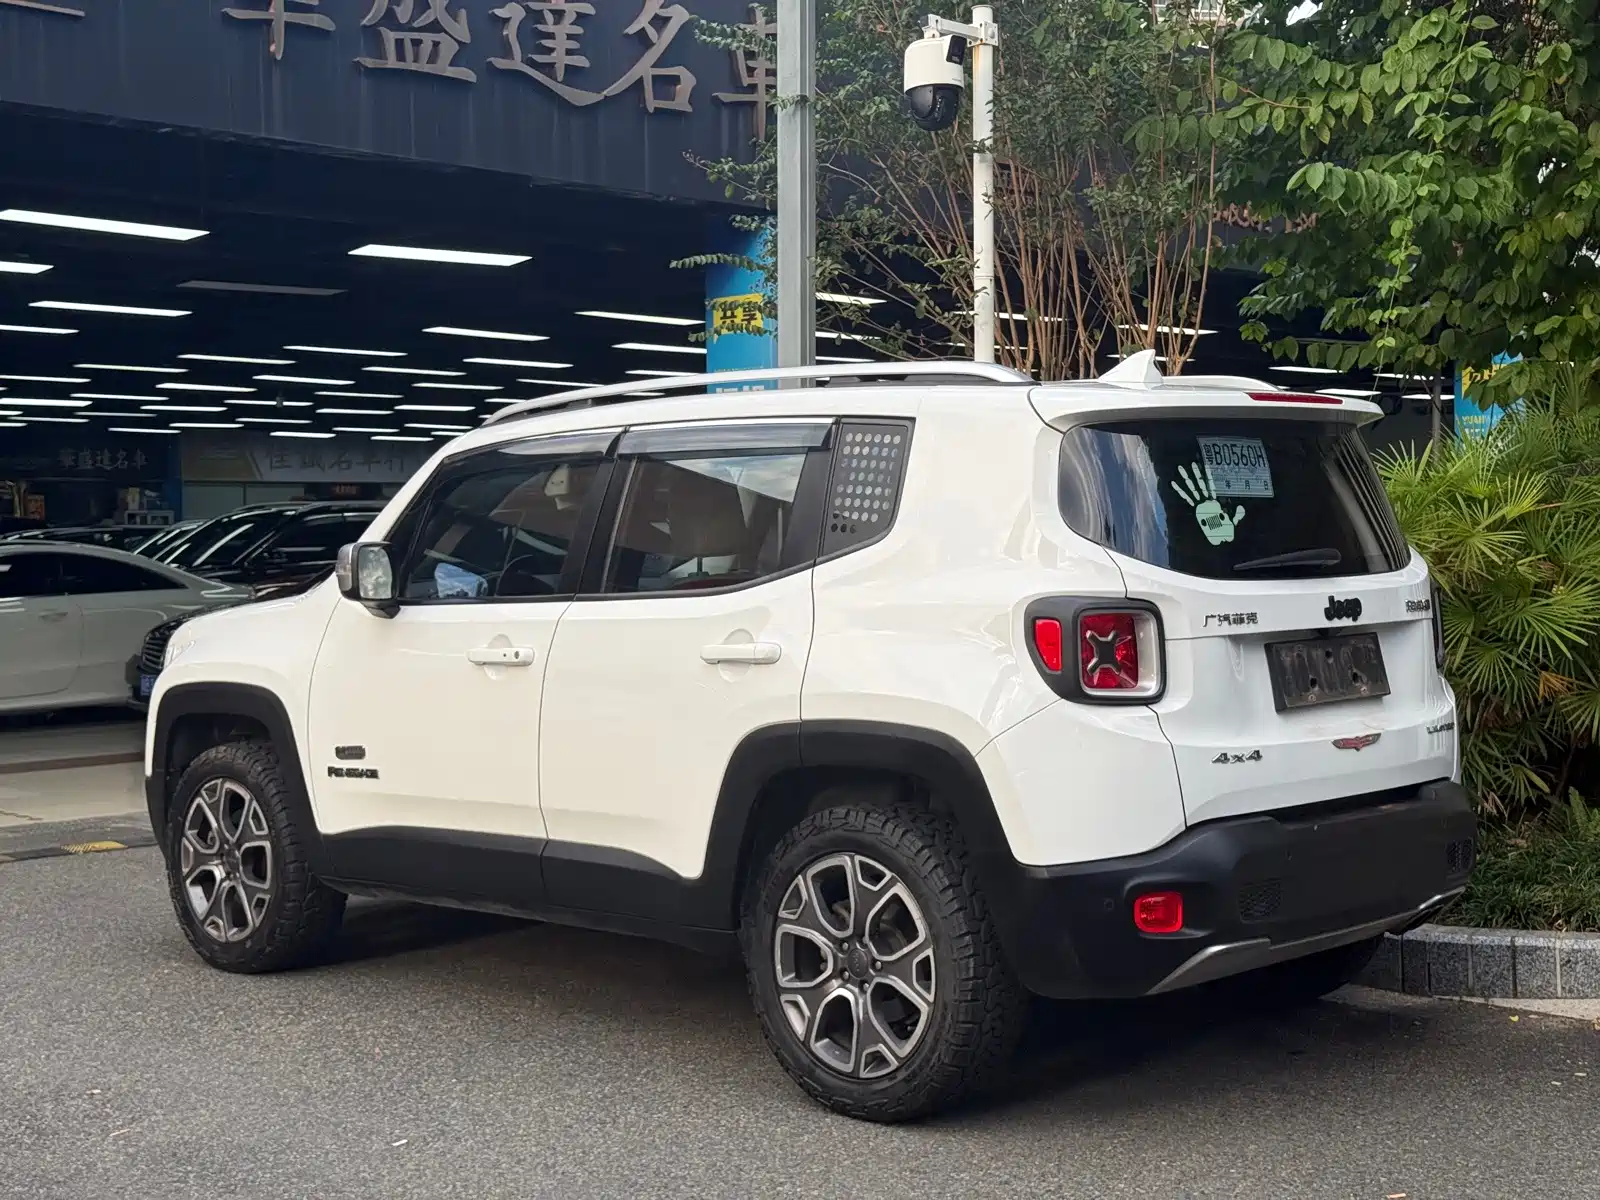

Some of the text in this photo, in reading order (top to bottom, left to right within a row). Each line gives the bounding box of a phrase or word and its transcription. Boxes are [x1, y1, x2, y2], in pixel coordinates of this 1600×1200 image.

[1324, 595, 1362, 622] Jeep
[1203, 612, 1259, 628] 广汽菲克
